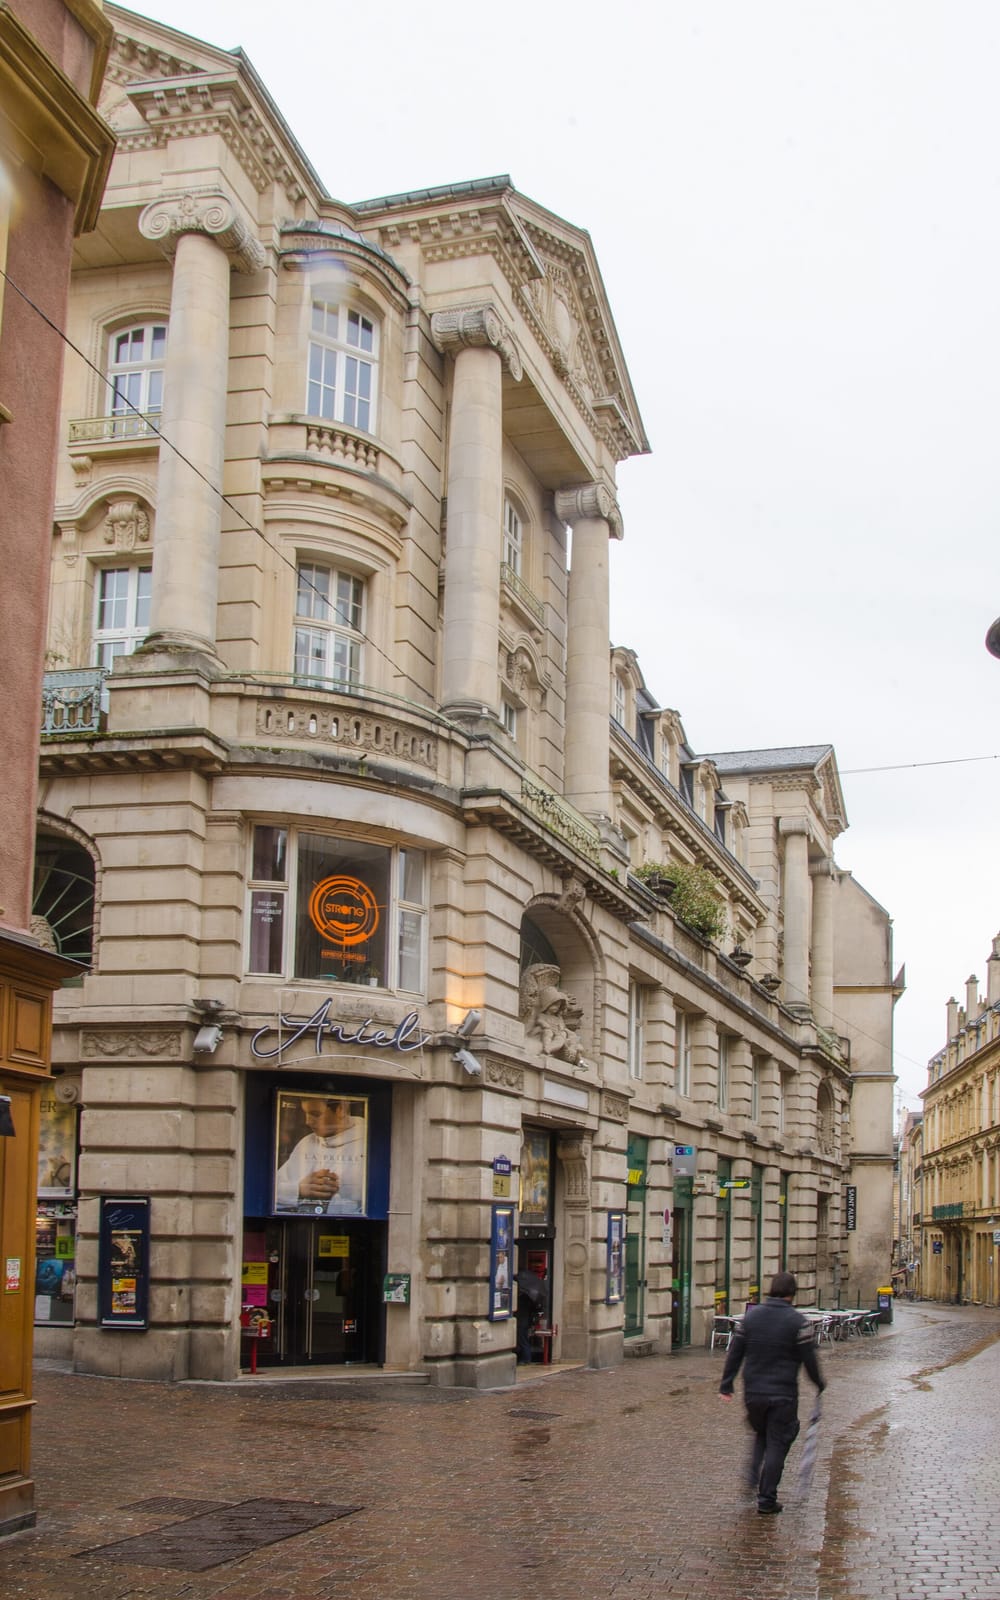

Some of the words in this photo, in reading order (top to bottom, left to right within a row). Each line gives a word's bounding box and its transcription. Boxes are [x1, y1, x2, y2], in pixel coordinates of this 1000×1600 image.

[325, 903, 365, 917] STRONG
[251, 997, 431, 1058] Ariel
[847, 1188, 855, 1206] SAINT
[847, 1207, 855, 1229] ALBAN
